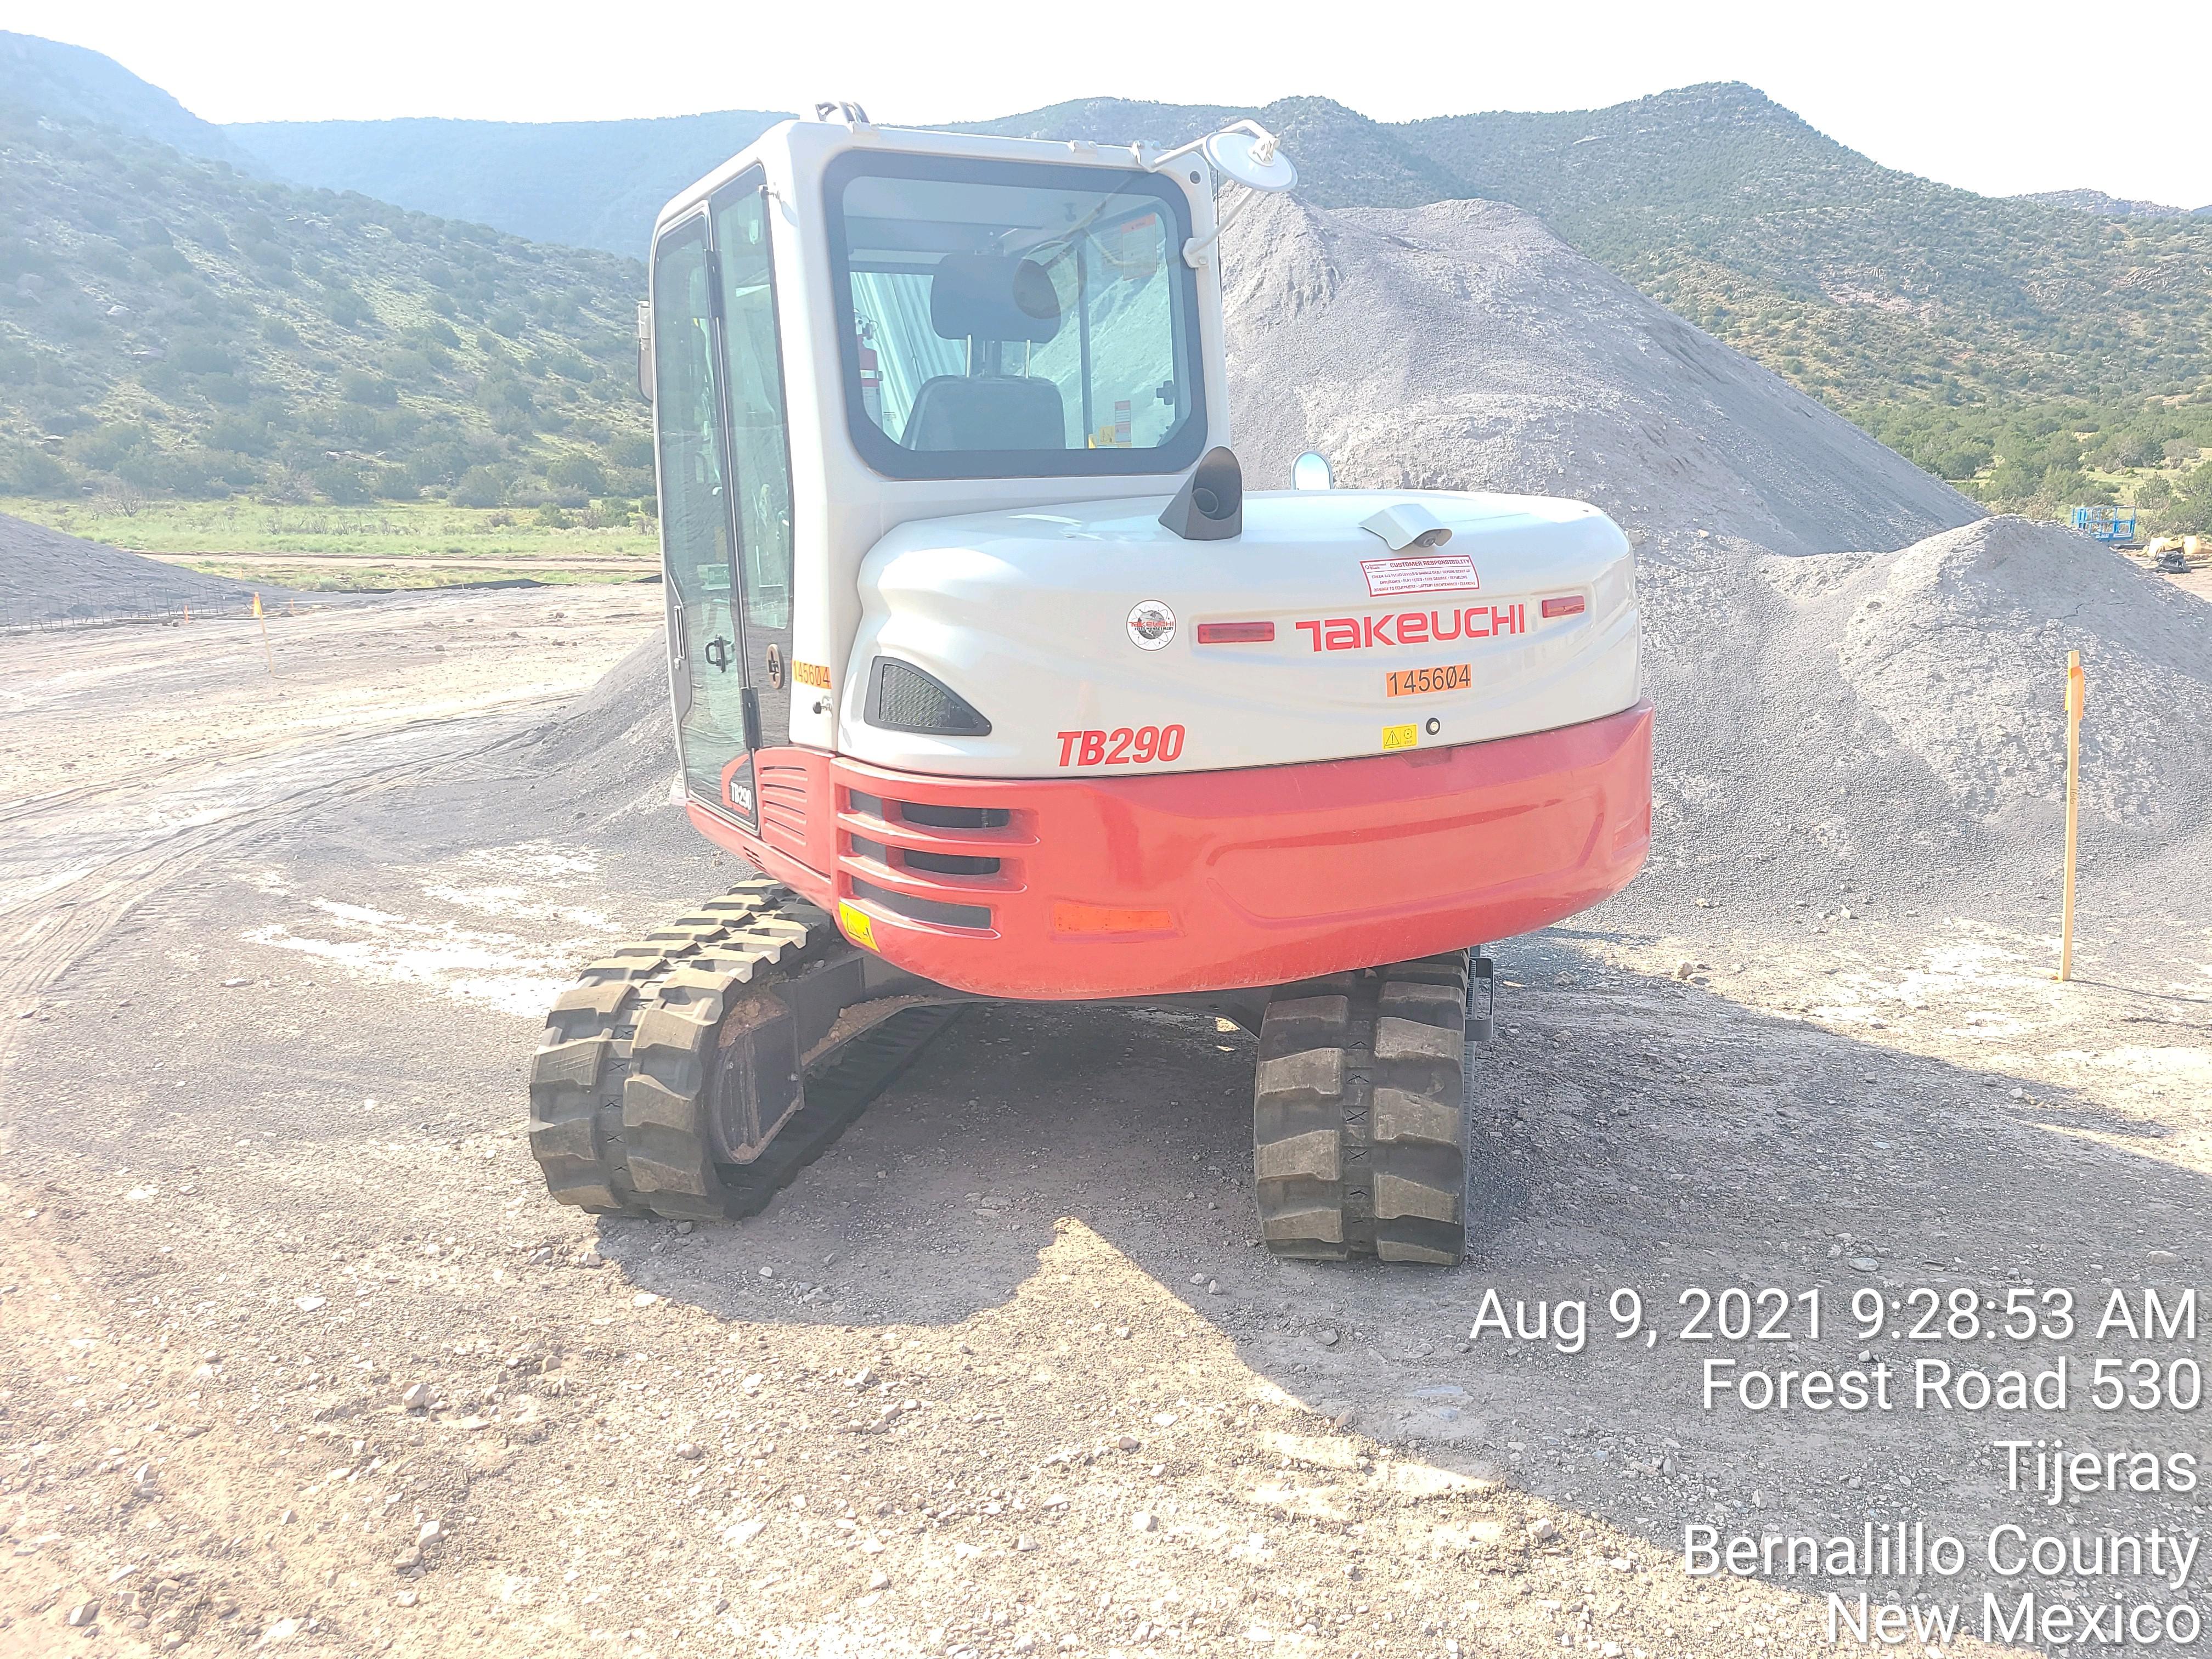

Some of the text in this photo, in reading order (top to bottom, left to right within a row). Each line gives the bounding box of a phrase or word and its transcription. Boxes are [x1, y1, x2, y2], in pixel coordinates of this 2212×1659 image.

[1295, 603, 1525, 652] TAKEUCHI
[793, 660, 830, 688] 145604
[1389, 663, 1471, 695] 145604
[1057, 724, 1186, 767] TB290
[730, 781, 752, 810] TB290
